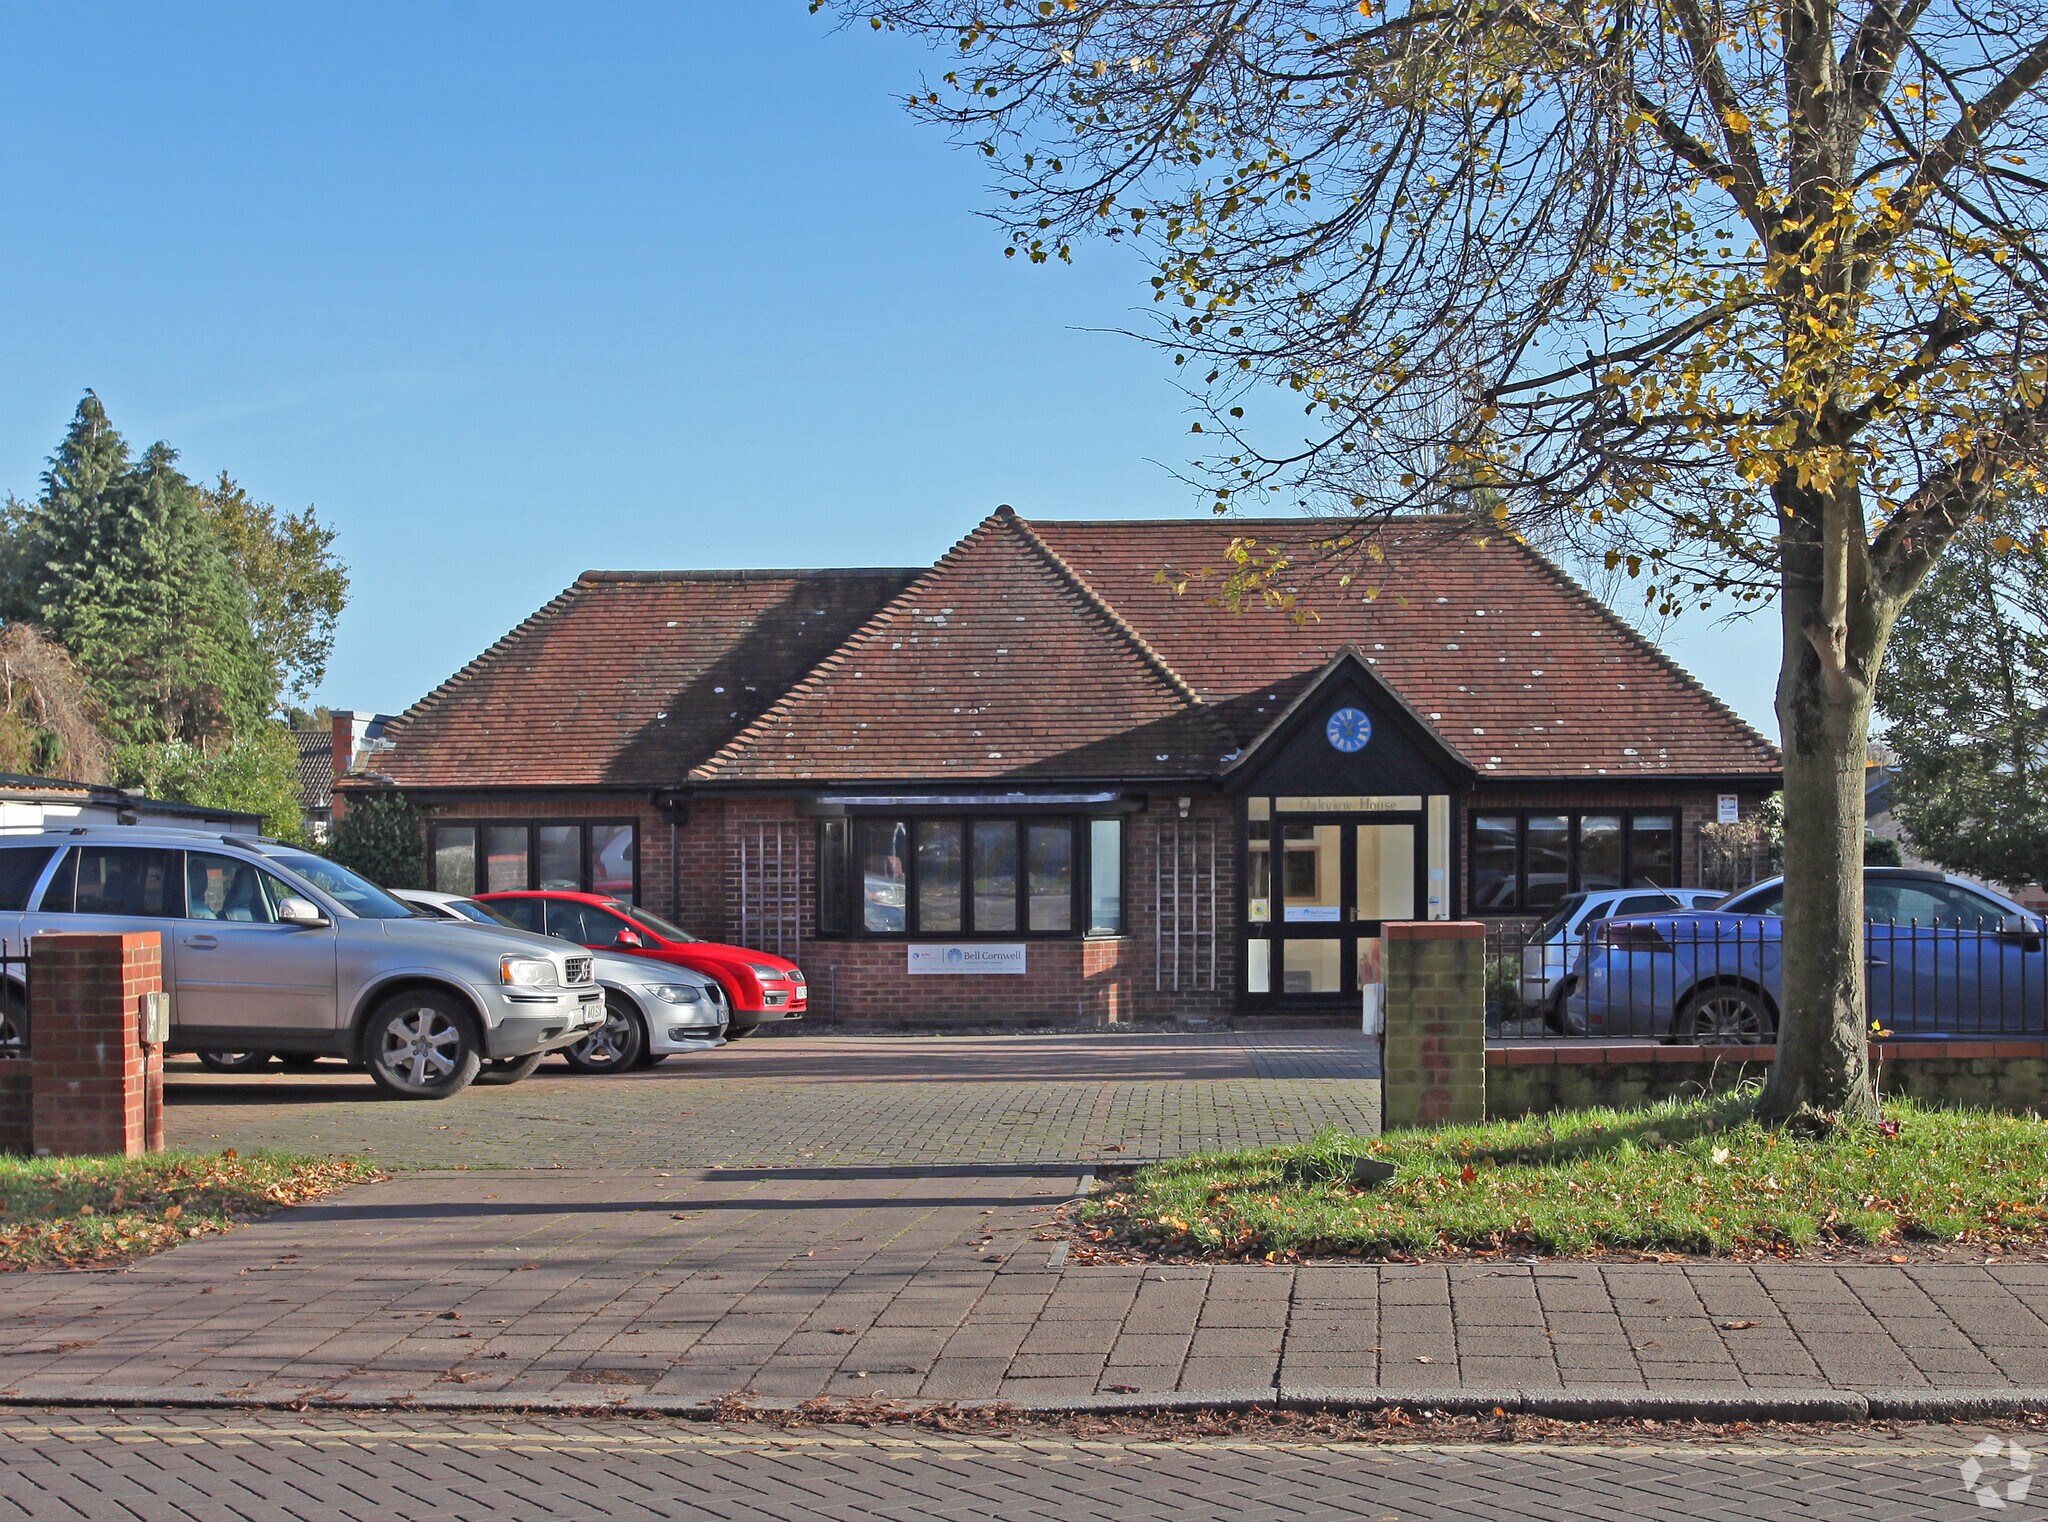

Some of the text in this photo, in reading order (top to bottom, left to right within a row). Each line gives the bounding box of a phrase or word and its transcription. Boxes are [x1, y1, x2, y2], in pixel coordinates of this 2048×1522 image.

[1300, 797, 1397, 811] Oakview House
[964, 950, 1021, 960] Bell Cornwell
